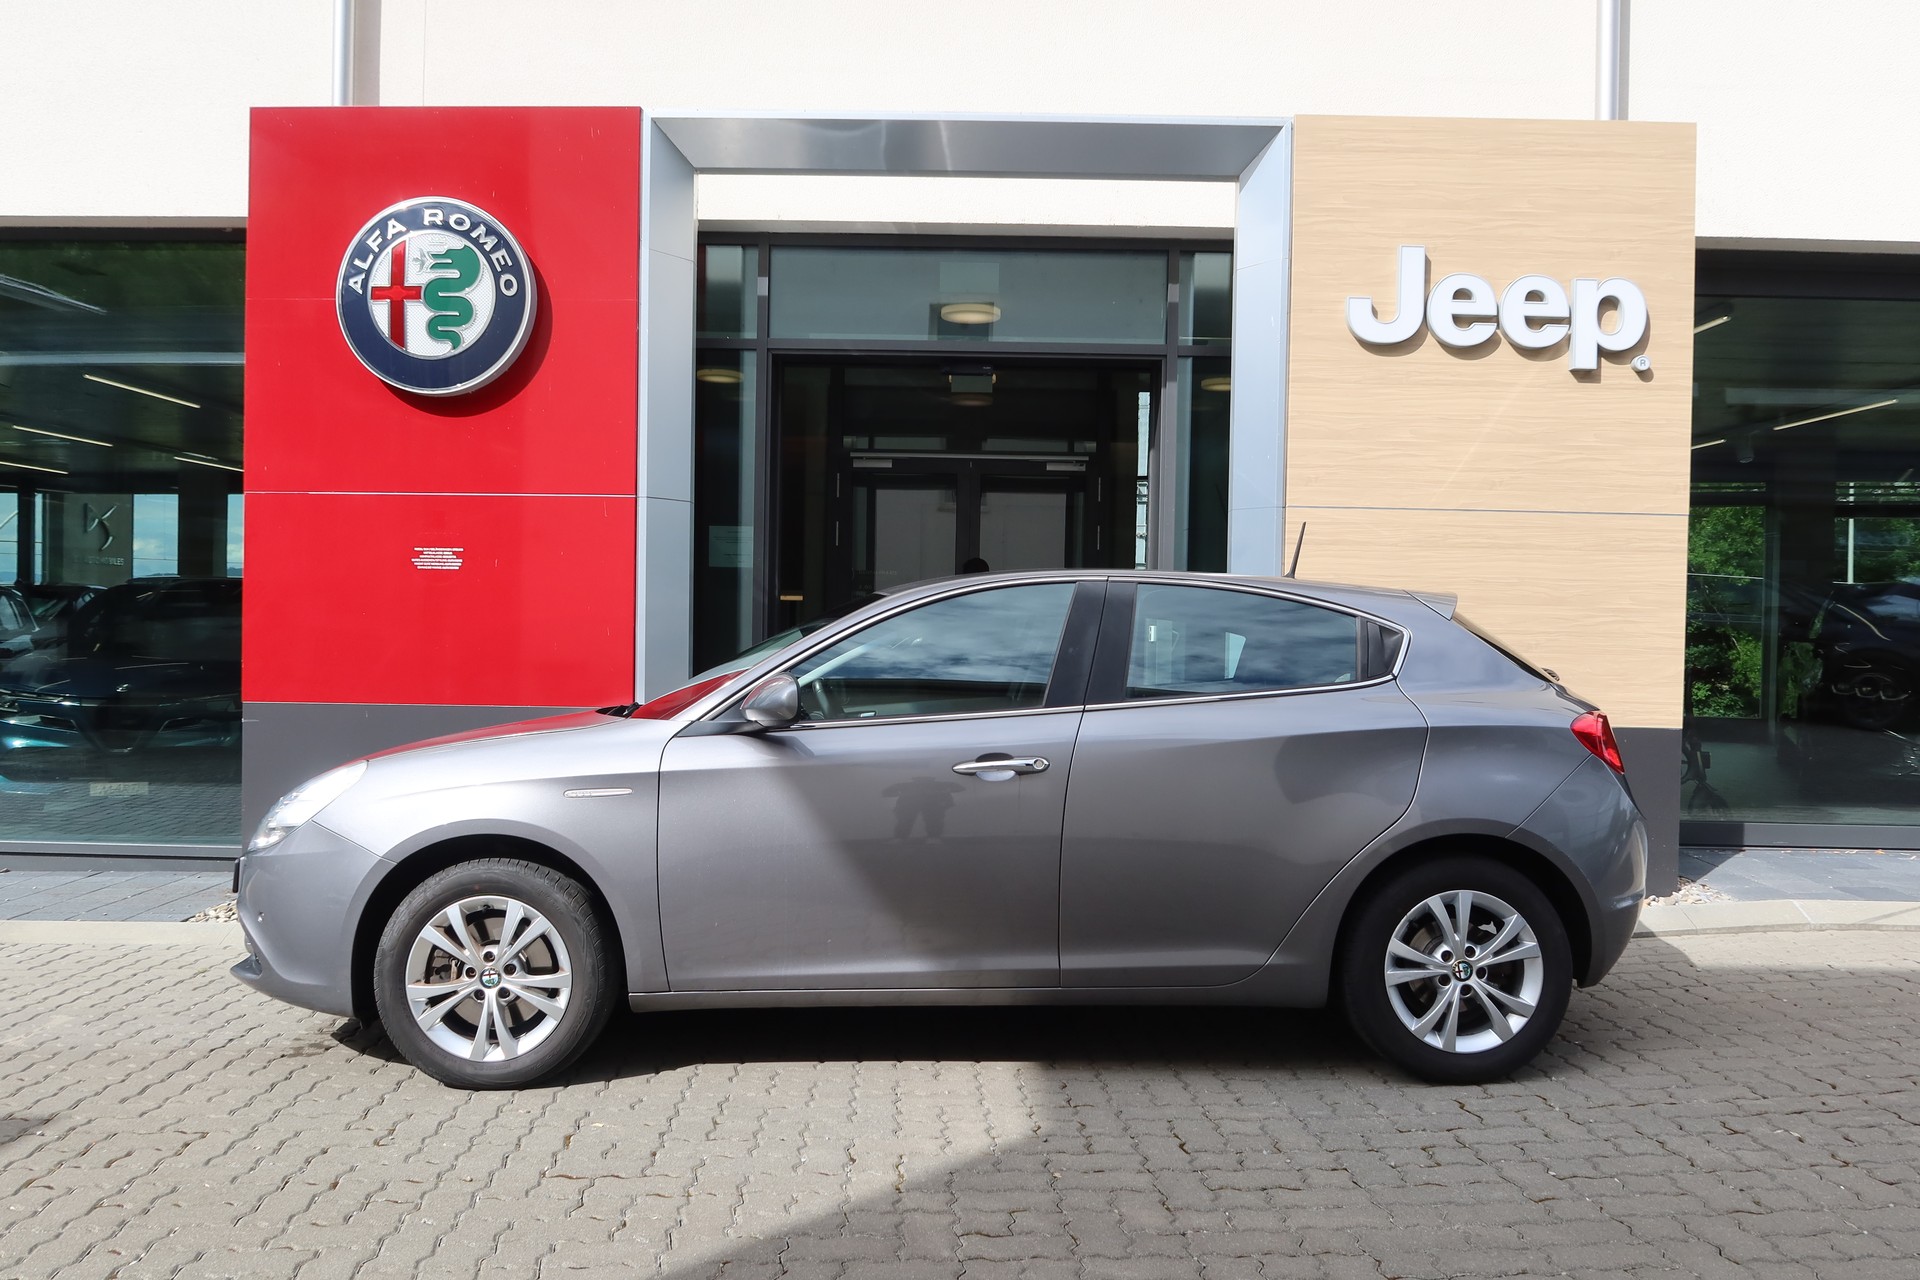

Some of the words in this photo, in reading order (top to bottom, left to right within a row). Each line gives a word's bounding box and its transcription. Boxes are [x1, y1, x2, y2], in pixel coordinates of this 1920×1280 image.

[348, 218, 408, 294] ALFA
[423, 208, 518, 296] ROMEO
[1345, 244, 1648, 371] Jeep
